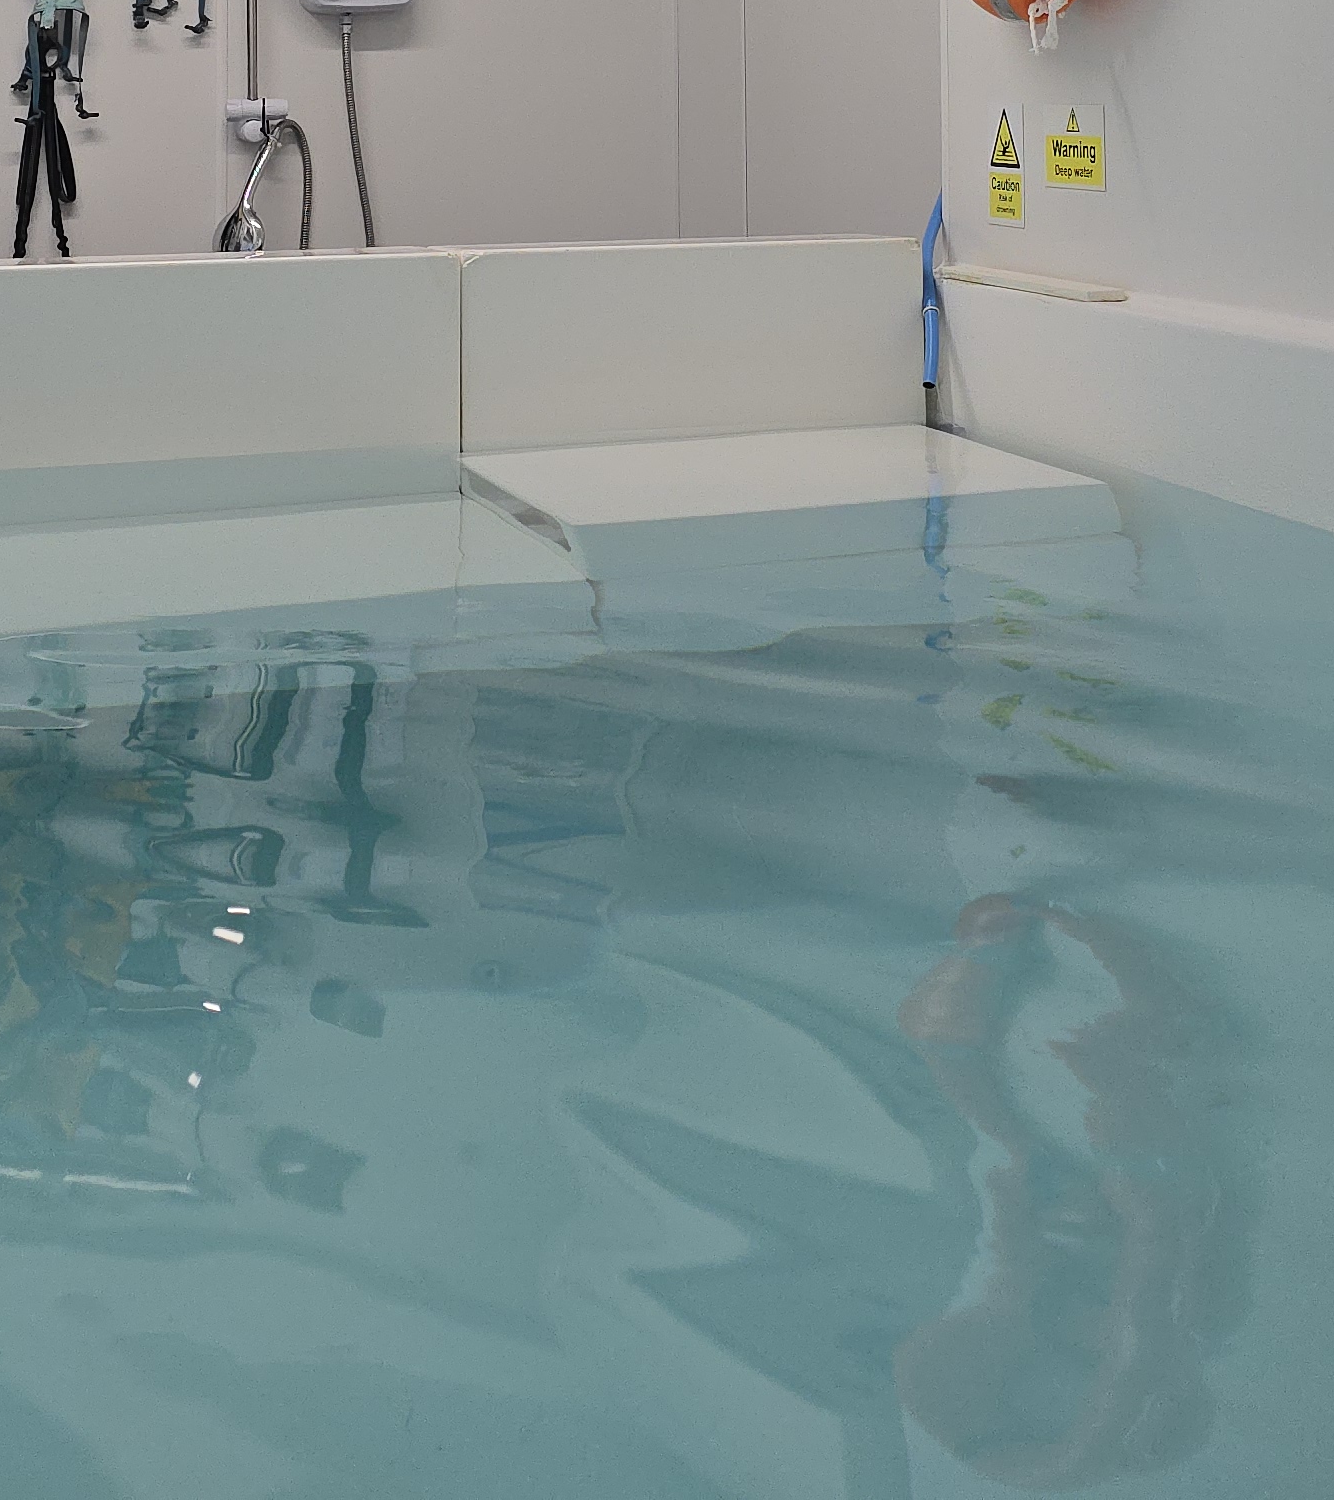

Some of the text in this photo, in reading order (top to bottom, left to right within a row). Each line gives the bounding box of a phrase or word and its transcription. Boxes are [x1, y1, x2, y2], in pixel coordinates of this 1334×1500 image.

[1052, 139, 1096, 164] Warning
[1054, 163, 1094, 180] Deep water
[991, 176, 1020, 192] Caution
